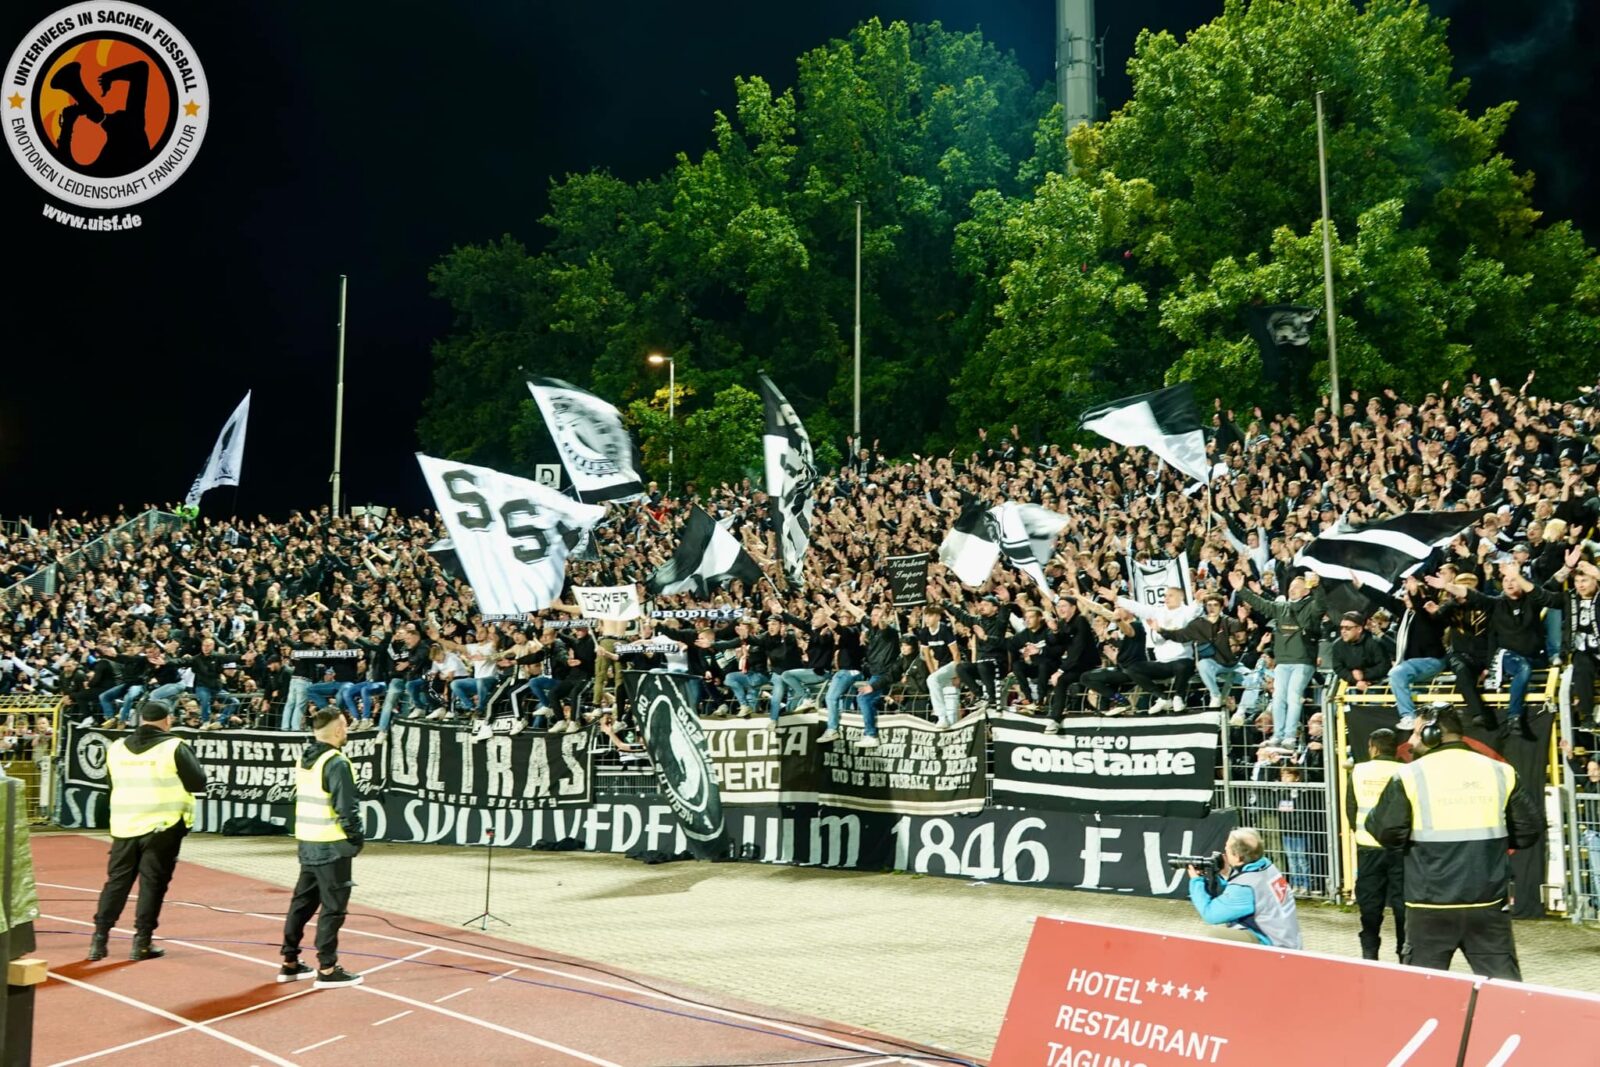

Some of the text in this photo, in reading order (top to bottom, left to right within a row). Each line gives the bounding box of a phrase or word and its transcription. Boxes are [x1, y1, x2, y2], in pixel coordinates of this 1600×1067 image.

[232, 740, 275, 761] FEST
[1076, 735, 1128, 750] nero
[391, 723, 588, 798] ULTRAS
[918, 760, 942, 776] RAD
[1011, 747, 1196, 776] constante
[418, 789, 558, 809] BROKEN SOCIETY
[891, 815, 1050, 883] 1846
[1066, 968, 1143, 1004] HOTEL
[1055, 1004, 1228, 1063] RESTAURANT
